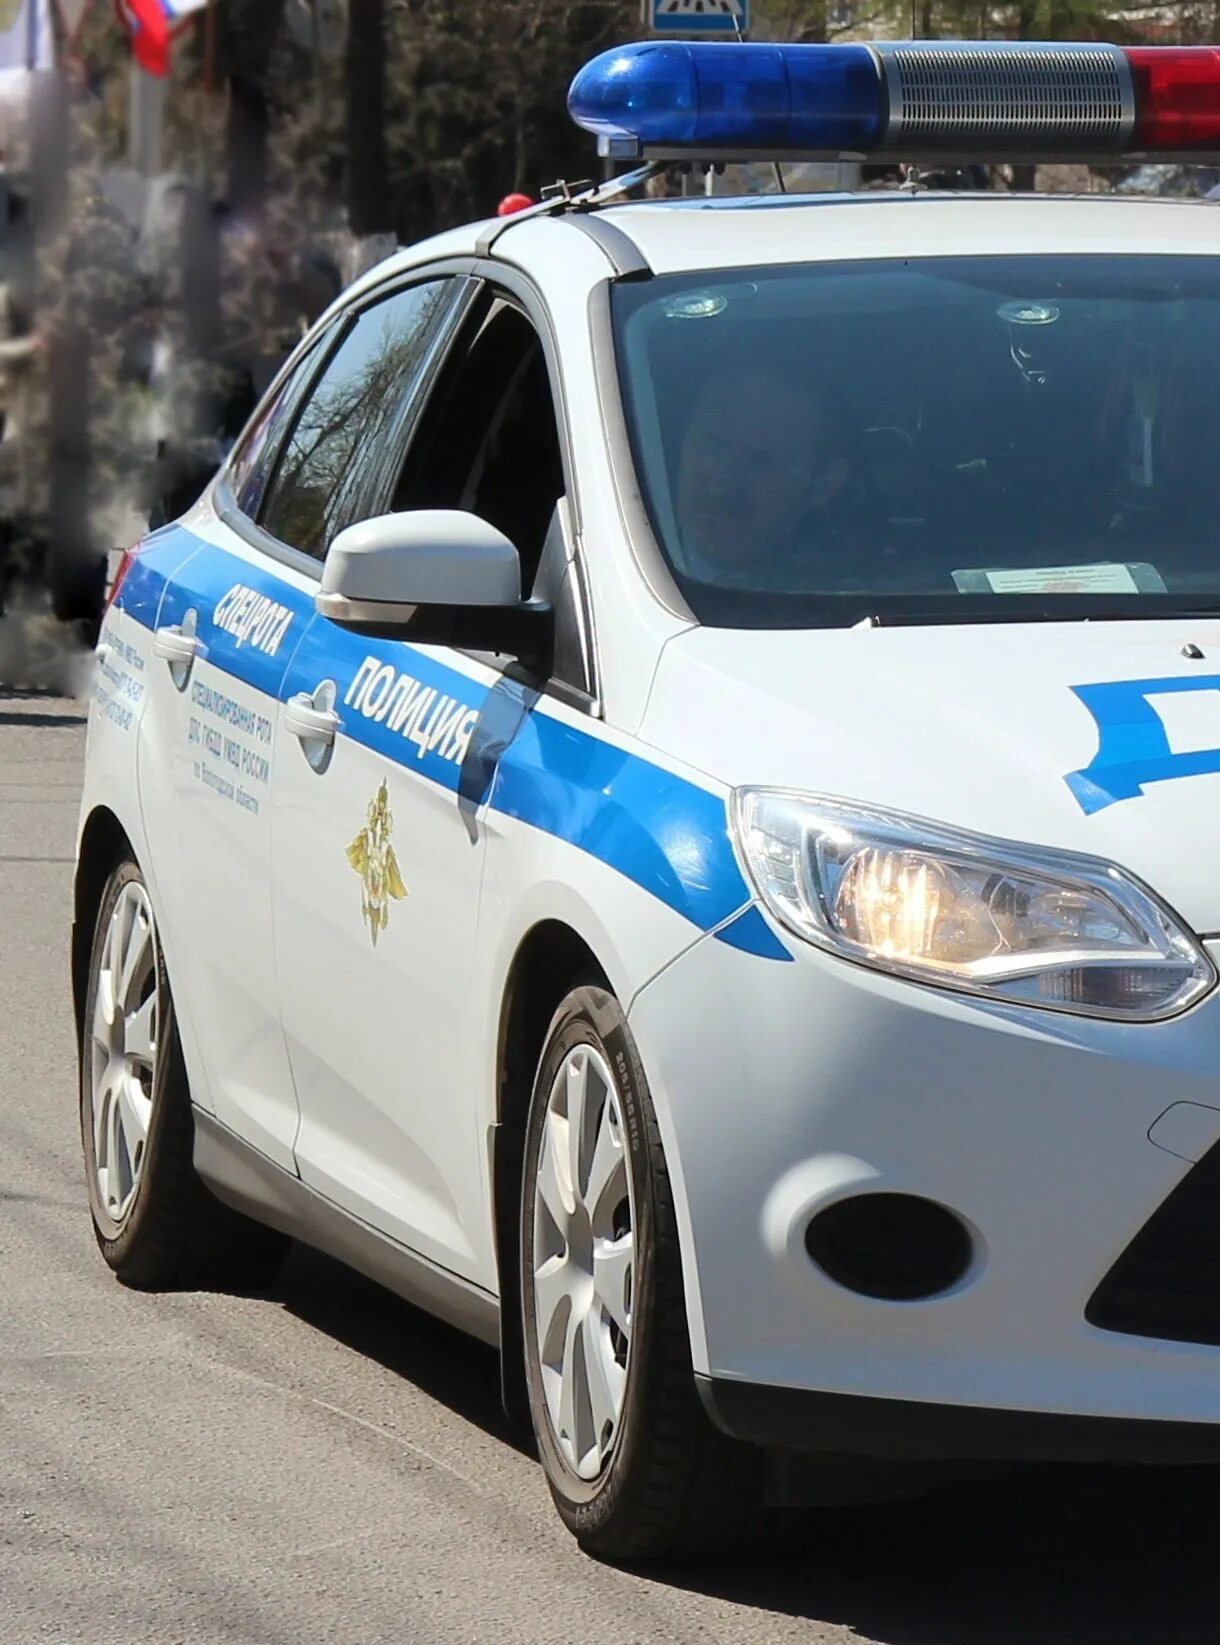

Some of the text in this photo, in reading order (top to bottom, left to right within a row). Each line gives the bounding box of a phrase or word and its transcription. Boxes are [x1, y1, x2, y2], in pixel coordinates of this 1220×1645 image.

[213, 584, 294, 657] СПЕЦРОТА
[344, 655, 479, 766] ПОЛИЦИЯ
[242, 747, 269, 784] РОССИИ
